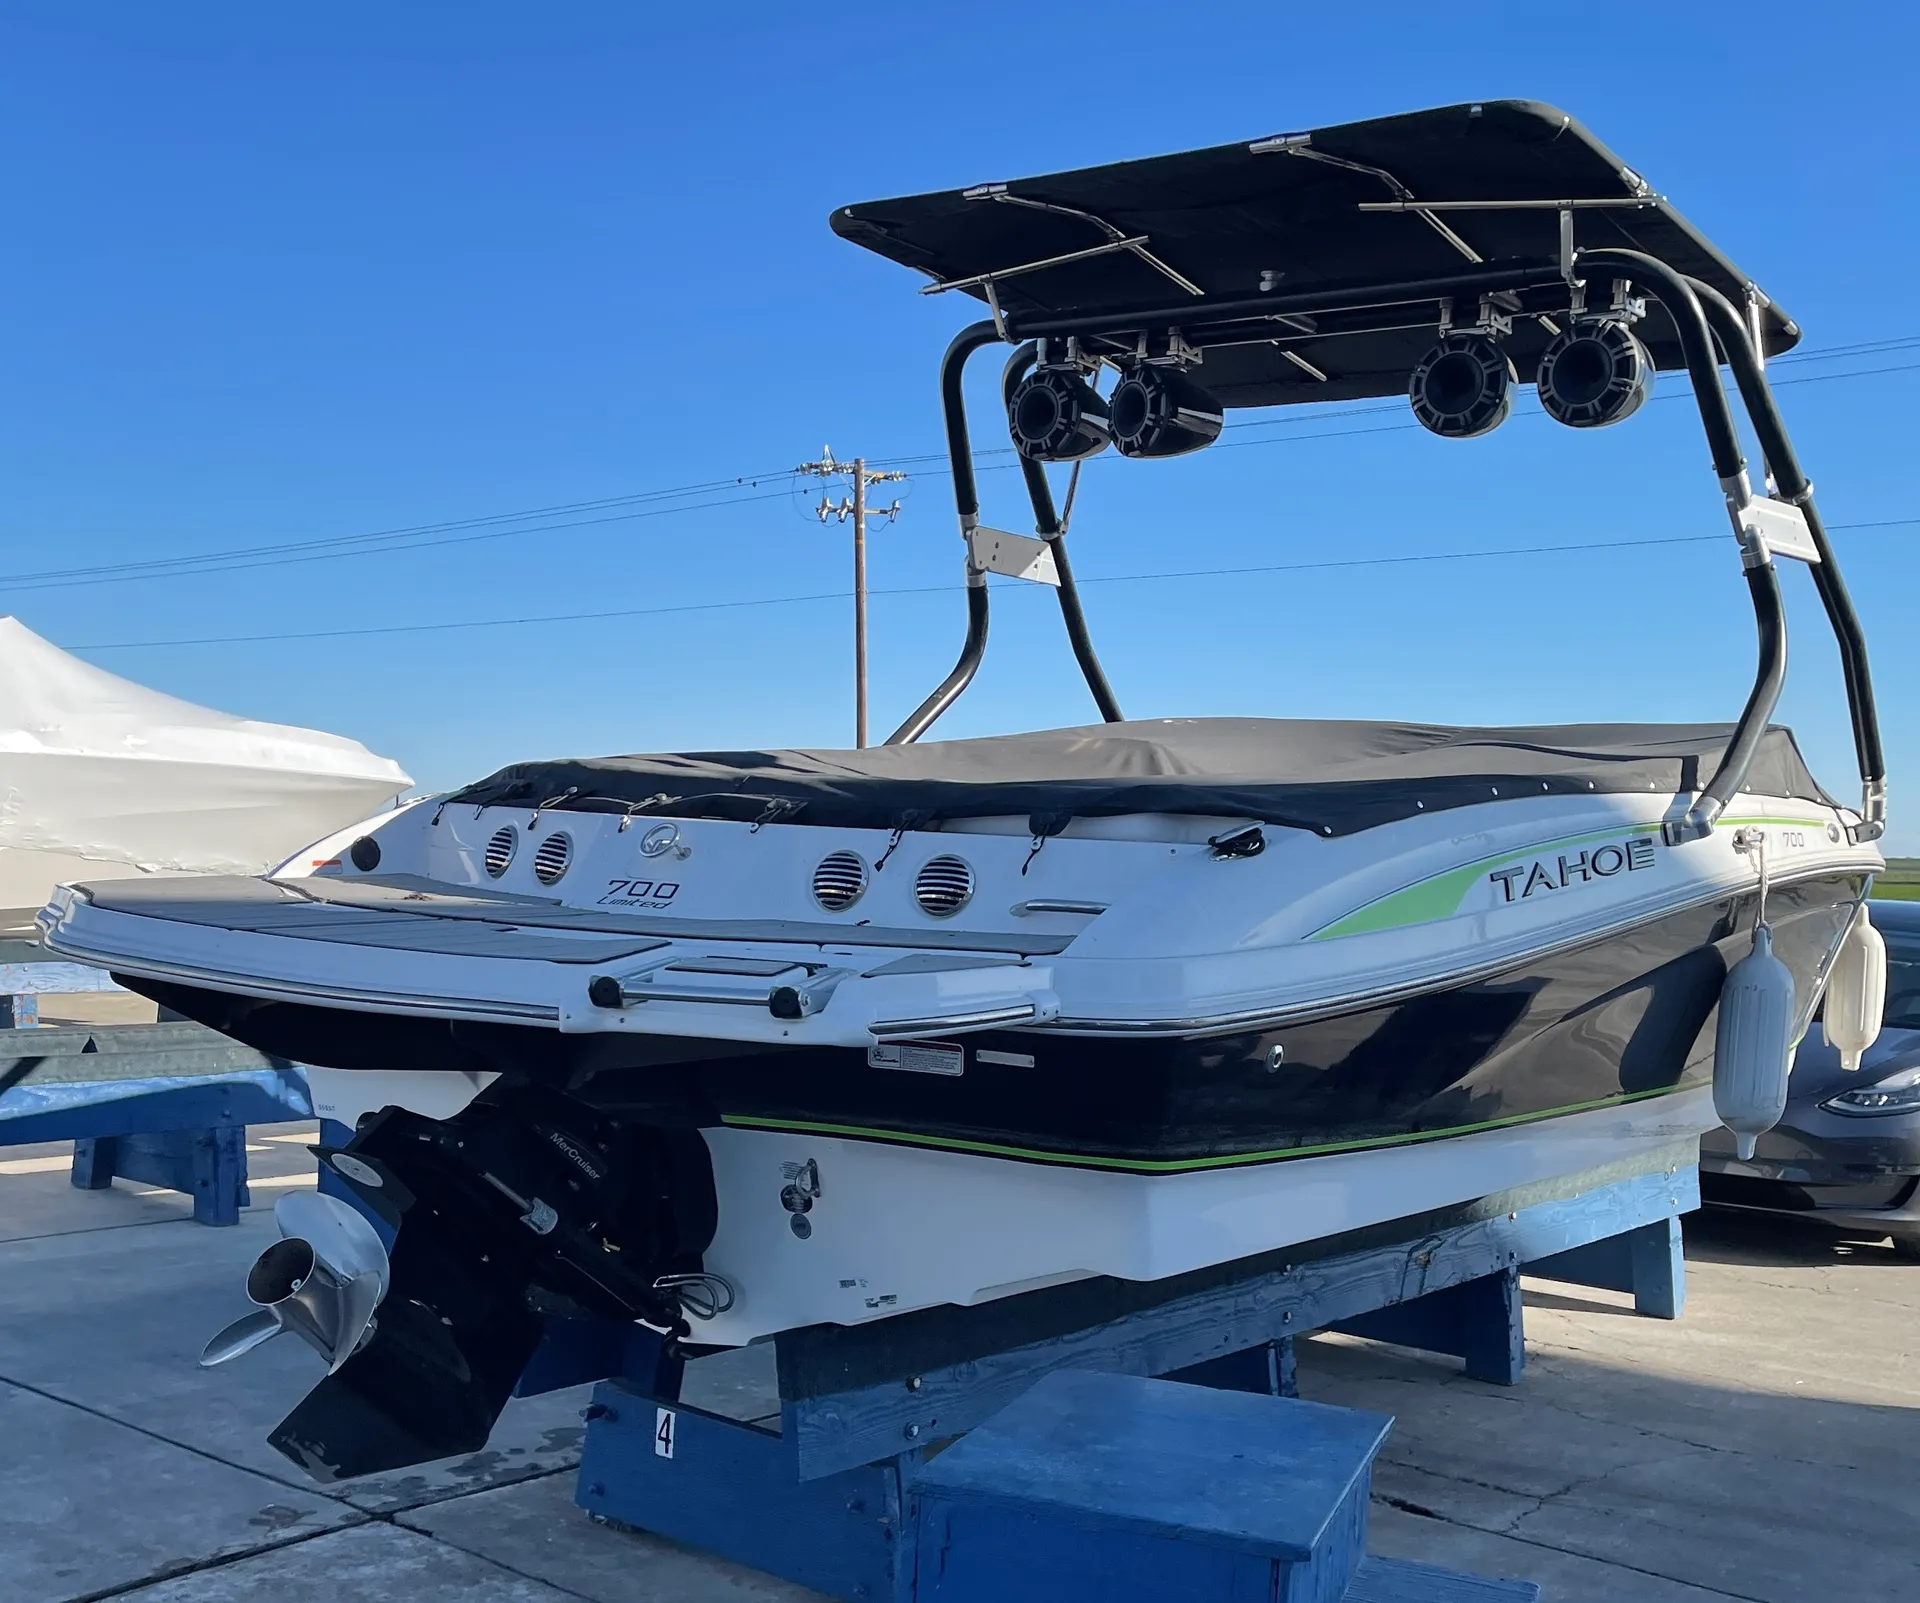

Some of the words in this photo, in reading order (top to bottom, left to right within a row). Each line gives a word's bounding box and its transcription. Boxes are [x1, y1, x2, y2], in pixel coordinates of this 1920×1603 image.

[1782, 832, 1804, 848] 700
[1489, 837, 1656, 902] TAHOE
[596, 895, 673, 909] Limited
[607, 879, 680, 899] 700
[549, 1132, 600, 1180] MerCruiser
[657, 1413, 672, 1454] 4
